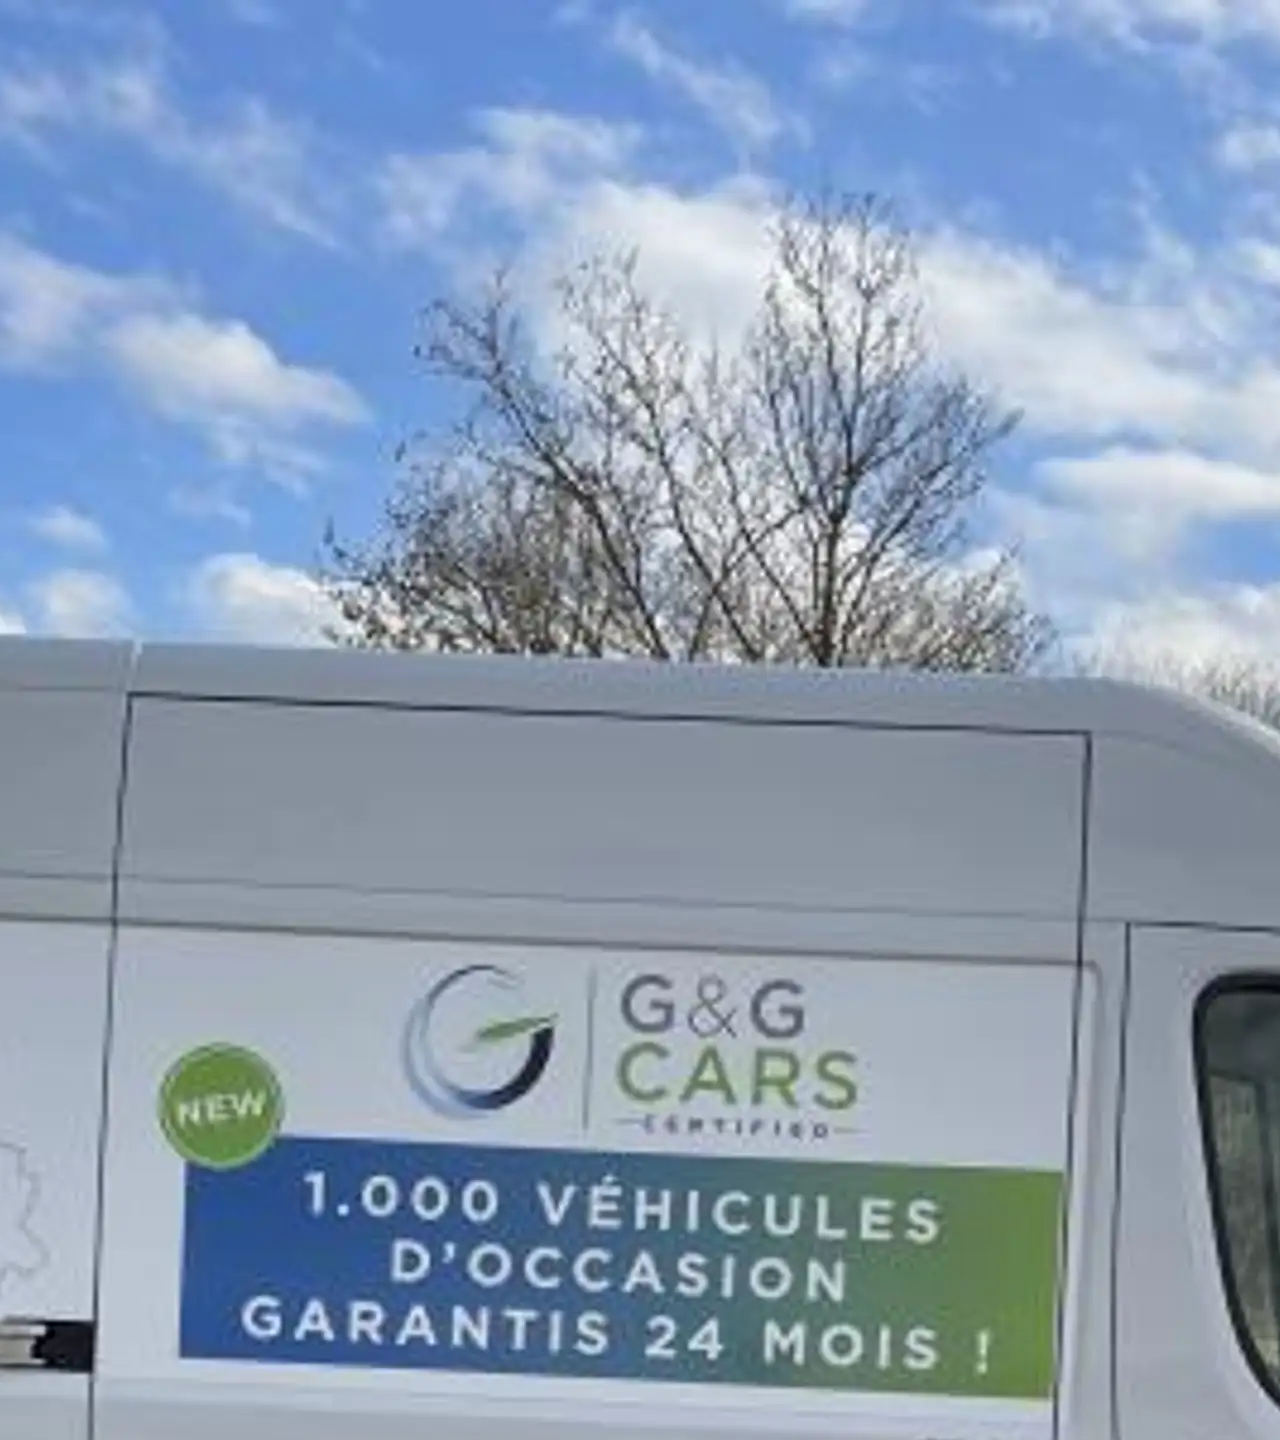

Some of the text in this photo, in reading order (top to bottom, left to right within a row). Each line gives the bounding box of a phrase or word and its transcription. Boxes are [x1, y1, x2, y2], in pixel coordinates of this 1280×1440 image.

[620, 973, 805, 1040] G&G
[178, 1088, 267, 1128] NEW
[617, 1041, 858, 1111] CARS
[642, 1114, 829, 1139] CERTIFIED
[304, 1171, 944, 1243] 1.000 VÉHICULES
[241, 1294, 610, 1355] GARANTIS
[644, 1313, 725, 1363] 24
[763, 1321, 939, 1372] MOIS
